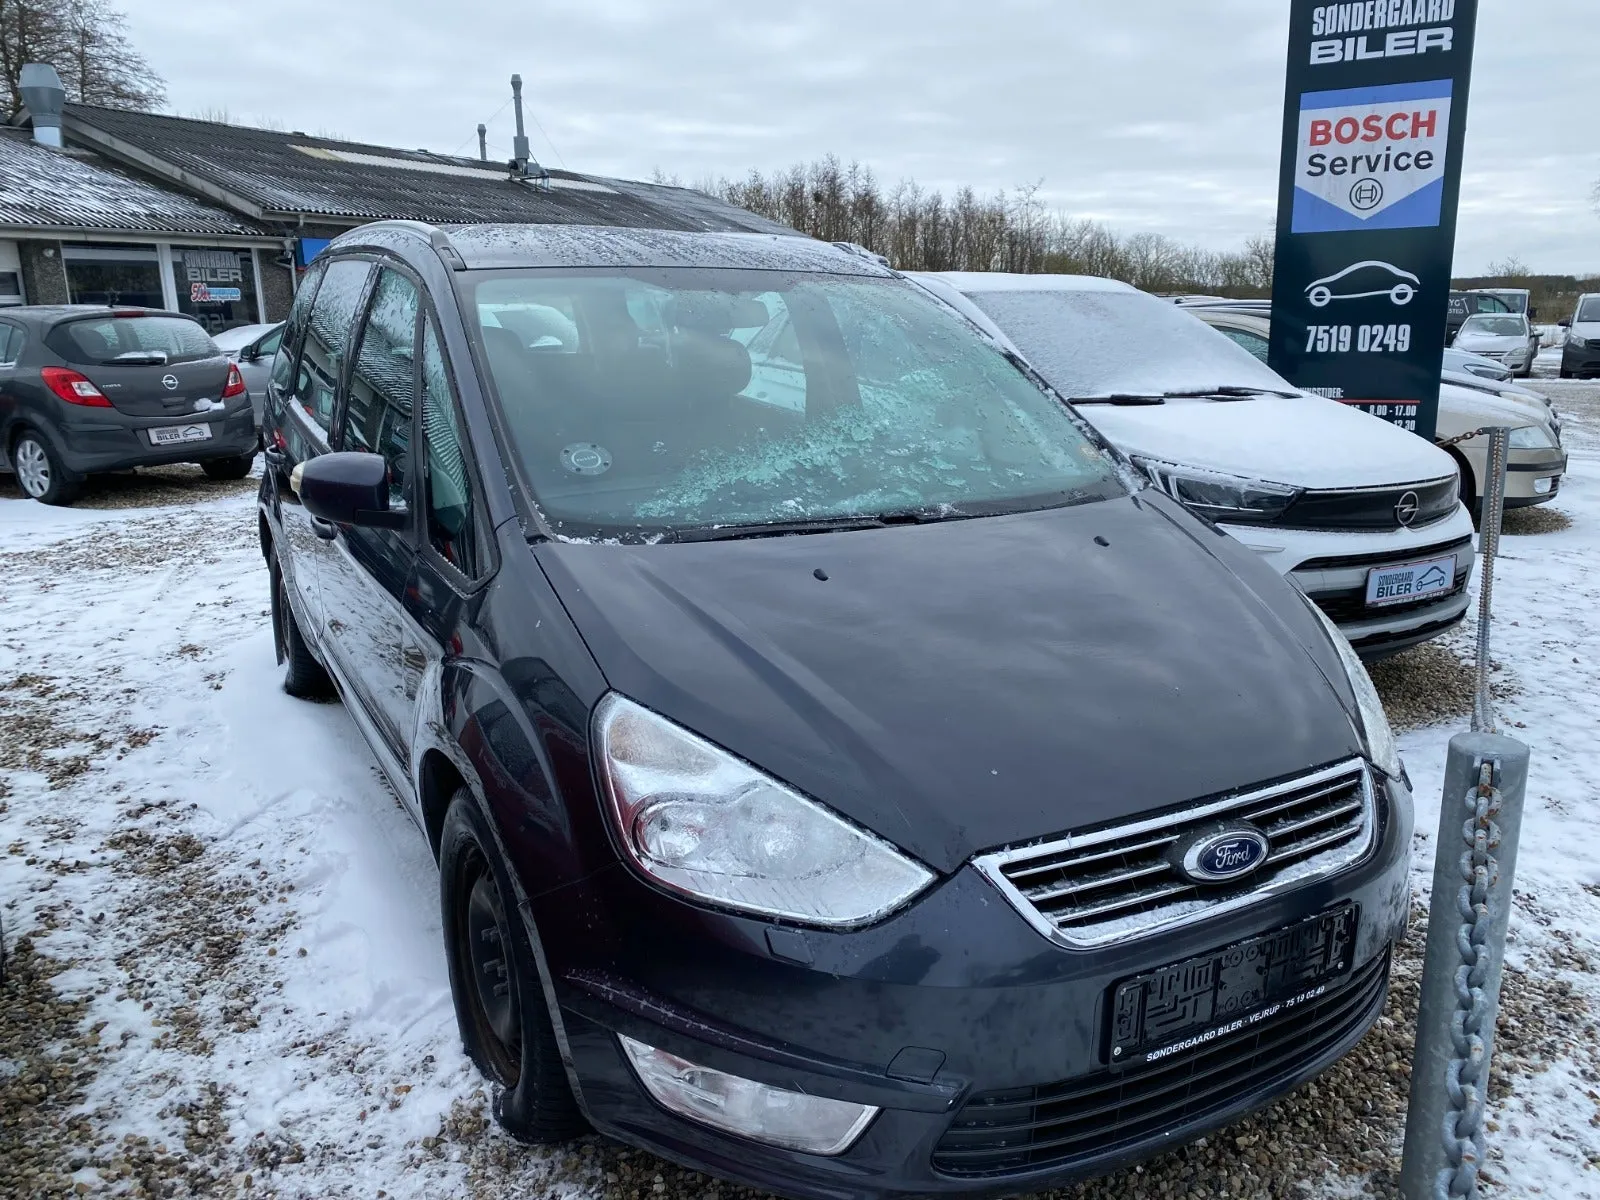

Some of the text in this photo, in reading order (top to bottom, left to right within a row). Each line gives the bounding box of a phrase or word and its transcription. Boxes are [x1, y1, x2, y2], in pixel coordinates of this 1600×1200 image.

[1312, 0, 1454, 36] SØNDERGAARD
[1309, 26, 1454, 65] BILER
[1309, 109, 1437, 147] BOSCH
[1306, 146, 1434, 177] Service
[187, 267, 243, 282] BILER
[1448, 298, 1461, 307] YG
[1305, 324, 1411, 353] 7519 0249
[1394, 405, 1417, 416] 17.00
[1376, 583, 1412, 598] BILER
[1215, 842, 1251, 869] Ford
[1146, 1029, 1216, 1062] SØNDERGAARD
[1217, 1018, 1243, 1036] BILER
[1249, 1004, 1280, 1023] VEJRUP
[1285, 998, 1295, 1008] 75
[1296, 993, 1305, 1004] 19
[1306, 989, 1316, 1000] 02
[1316, 985, 1325, 996] 49
